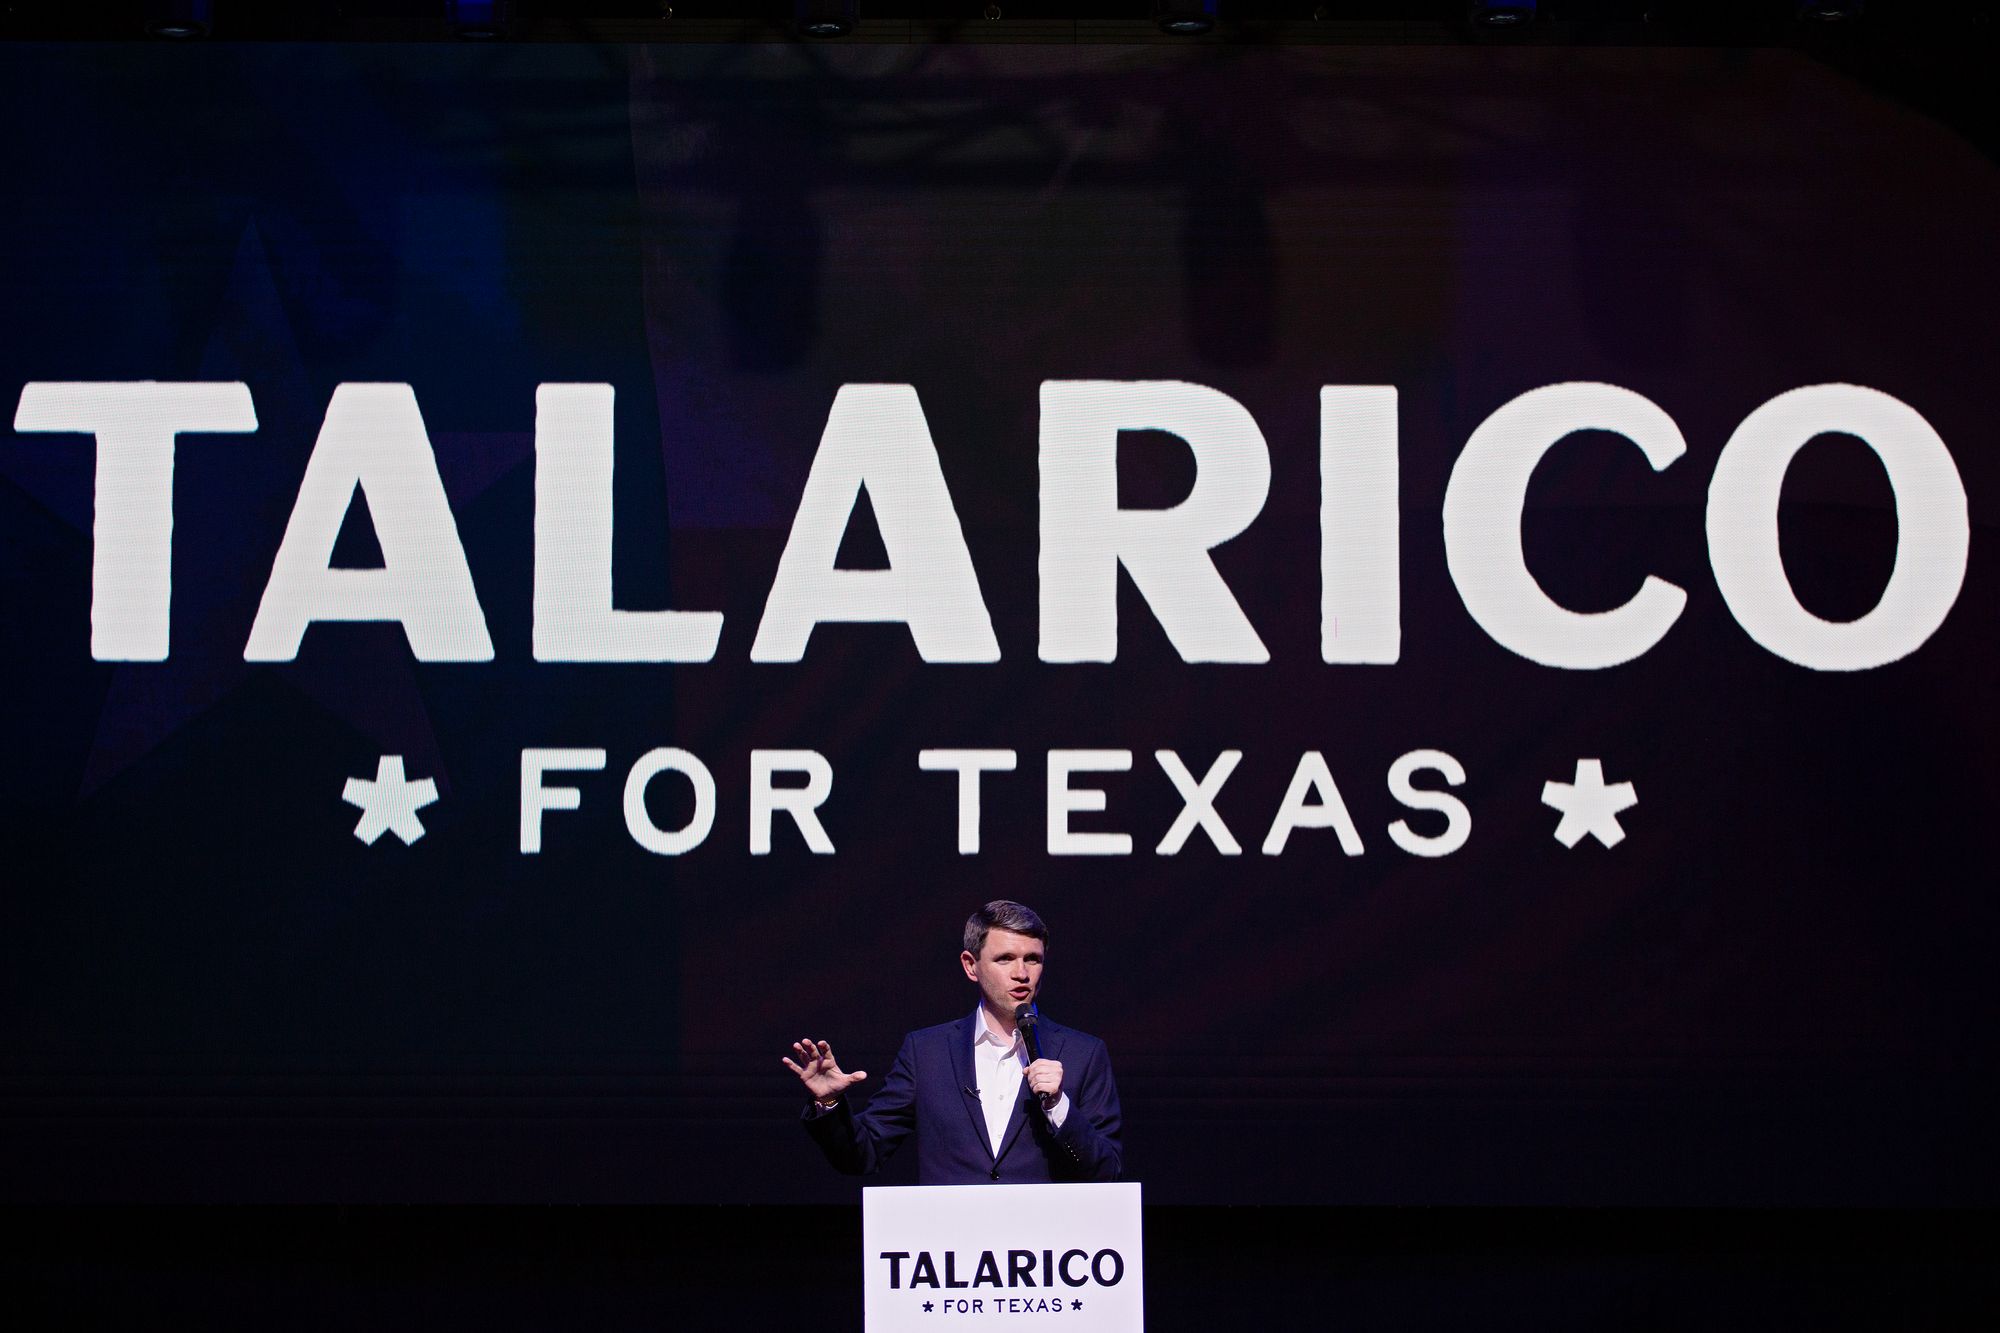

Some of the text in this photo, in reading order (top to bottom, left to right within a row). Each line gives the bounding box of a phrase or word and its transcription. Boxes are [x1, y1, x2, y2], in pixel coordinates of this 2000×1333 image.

[14, 380, 1970, 671] TALARICO
[519, 748, 1472, 858] FOR TEXAS
[880, 1249, 1125, 1289] TALARICO
[943, 1298, 1063, 1314] FOR TEXAS
